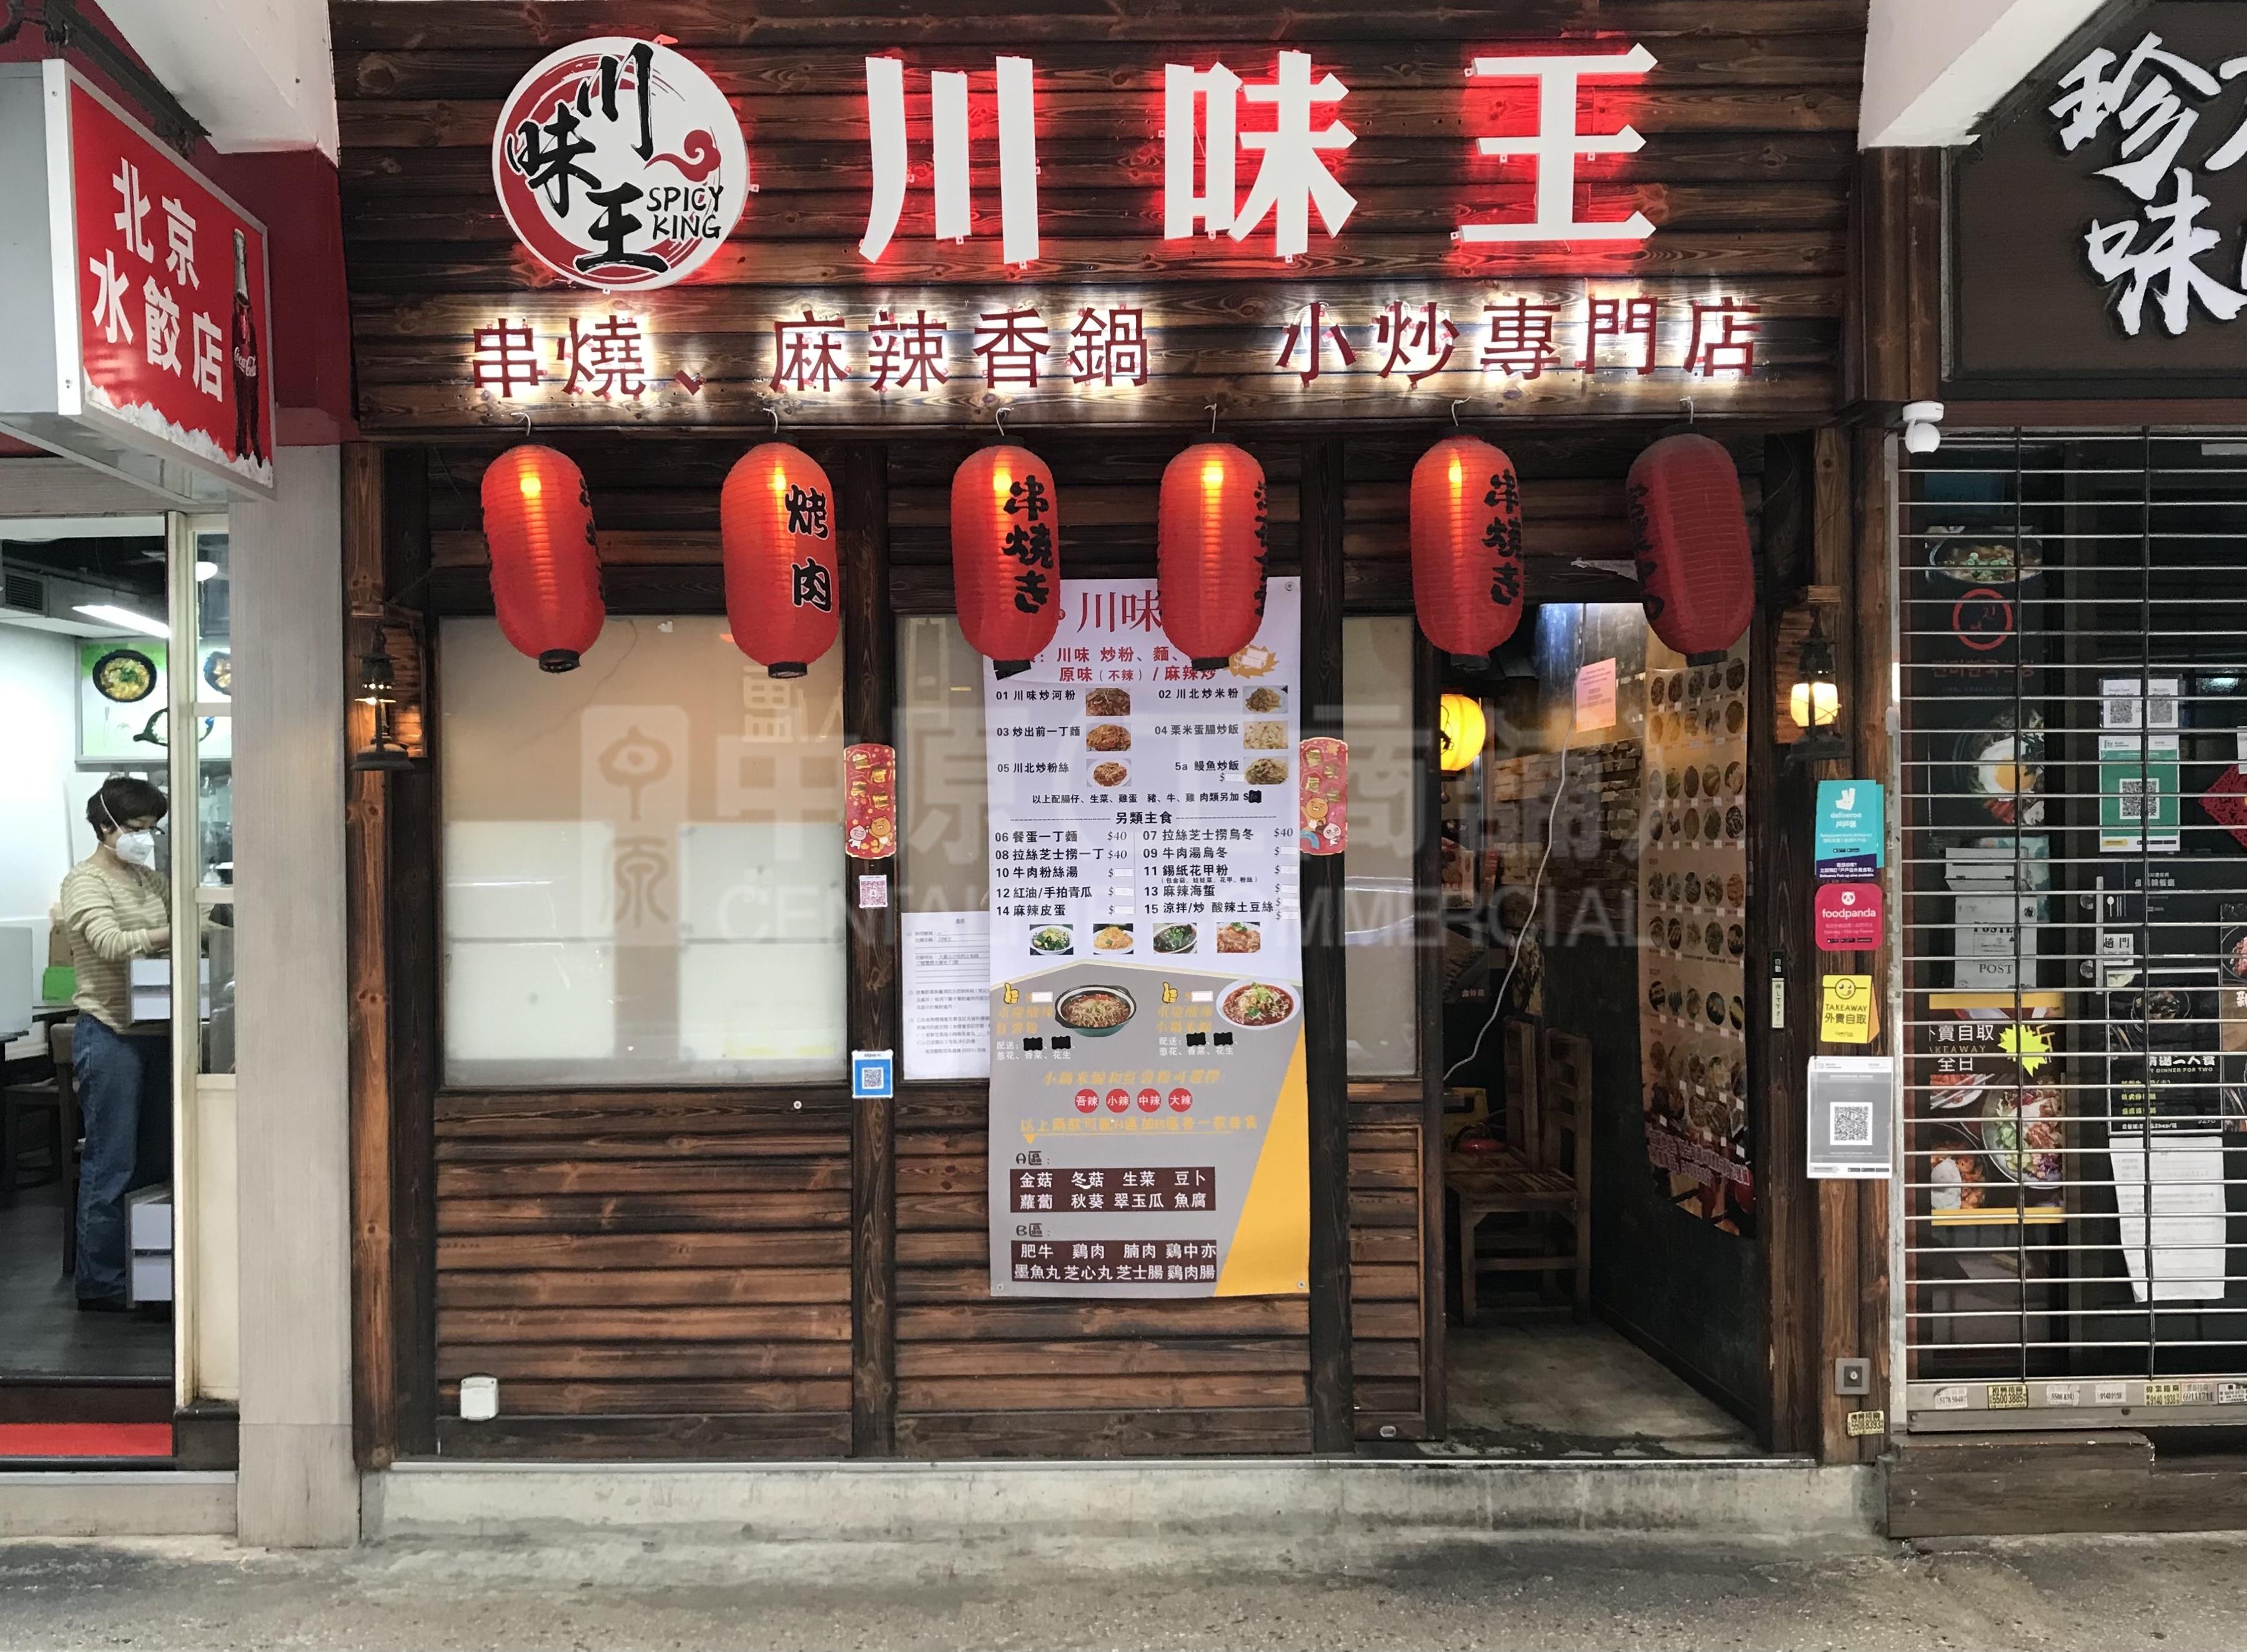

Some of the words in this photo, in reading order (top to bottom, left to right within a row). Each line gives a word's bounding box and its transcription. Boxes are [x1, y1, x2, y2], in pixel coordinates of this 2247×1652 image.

[859, 42, 1658, 264] 川味王
[646, 185, 724, 212] SPICY
[112, 157, 200, 290] 北京
[653, 214, 721, 242] KING
[89, 248, 223, 403] 水餃店
[769, 307, 1148, 393] 麻辣香鍋
[1276, 297, 1761, 388] 小炒專門店
[996, 691, 1008, 700] 01
[1013, 690, 1075, 701] 川味炒河粉
[1158, 690, 1171, 699] 02
[1176, 688, 1238, 700] 川北炒米粉
[997, 728, 1009, 736] 03
[1013, 726, 1080, 737] 炒出前一丁麵
[1155, 726, 1167, 735] 04
[997, 764, 1010, 773] 05
[1013, 762, 1069, 773] 川北炒粉絲
[1175, 762, 1188, 771] 5a
[1194, 760, 1240, 771] 鰻魚炒飯
[995, 833, 1009, 843] 06
[1012, 831, 1078, 843] 餐蛋一丁麵
[1107, 831, 1127, 842] $40
[1143, 831, 1157, 841] 07
[1274, 828, 1293, 838] $40
[995, 850, 1009, 860] 08
[1012, 848, 1104, 861] 拉絲芝士撈一丁
[1107, 849, 1127, 860] $40
[1143, 848, 1158, 858] 09
[996, 868, 1009, 878] 10
[1012, 866, 1079, 879] 牛肉粉絲湯
[1143, 866, 1157, 876] 11
[1162, 864, 1228, 877] 錫紙花甲粉
[996, 888, 1010, 898] 12
[1144, 886, 1158, 896] 13
[996, 906, 1009, 916] 14
[1013, 904, 1066, 916] 麻辣皮蛋
[1145, 904, 1158, 914] 15
[1212, 901, 1274, 913] 酸辣土豆絲
[1822, 908, 1876, 920] foodpanda
[1979, 964, 2013, 974] POST
[1824, 1012, 1867, 1024] 外賣自取
[1107, 1096, 1129, 1106] 小辣
[1138, 1095, 1160, 1106] 中辣
[1170, 1094, 1192, 1105] 大辣
[1020, 1172, 1053, 1188] 金菇
[1071, 1171, 1104, 1188] 冬菇
[1123, 1170, 1155, 1187] 生菜
[1175, 1170, 1206, 1186] 豆卜
[1071, 1193, 1104, 1209] 秋葵
[1114, 1192, 1164, 1209] 翠玉瓜
[1174, 1192, 1207, 1209] 魚腐
[1020, 1244, 1054, 1259] 肥牛
[1124, 1243, 1156, 1259] 腩肉
[1014, 1264, 1061, 1280] 墨魚丸
[1064, 1265, 1113, 1280] 芝心丸
[1116, 1265, 1164, 1280] 芝士腸
